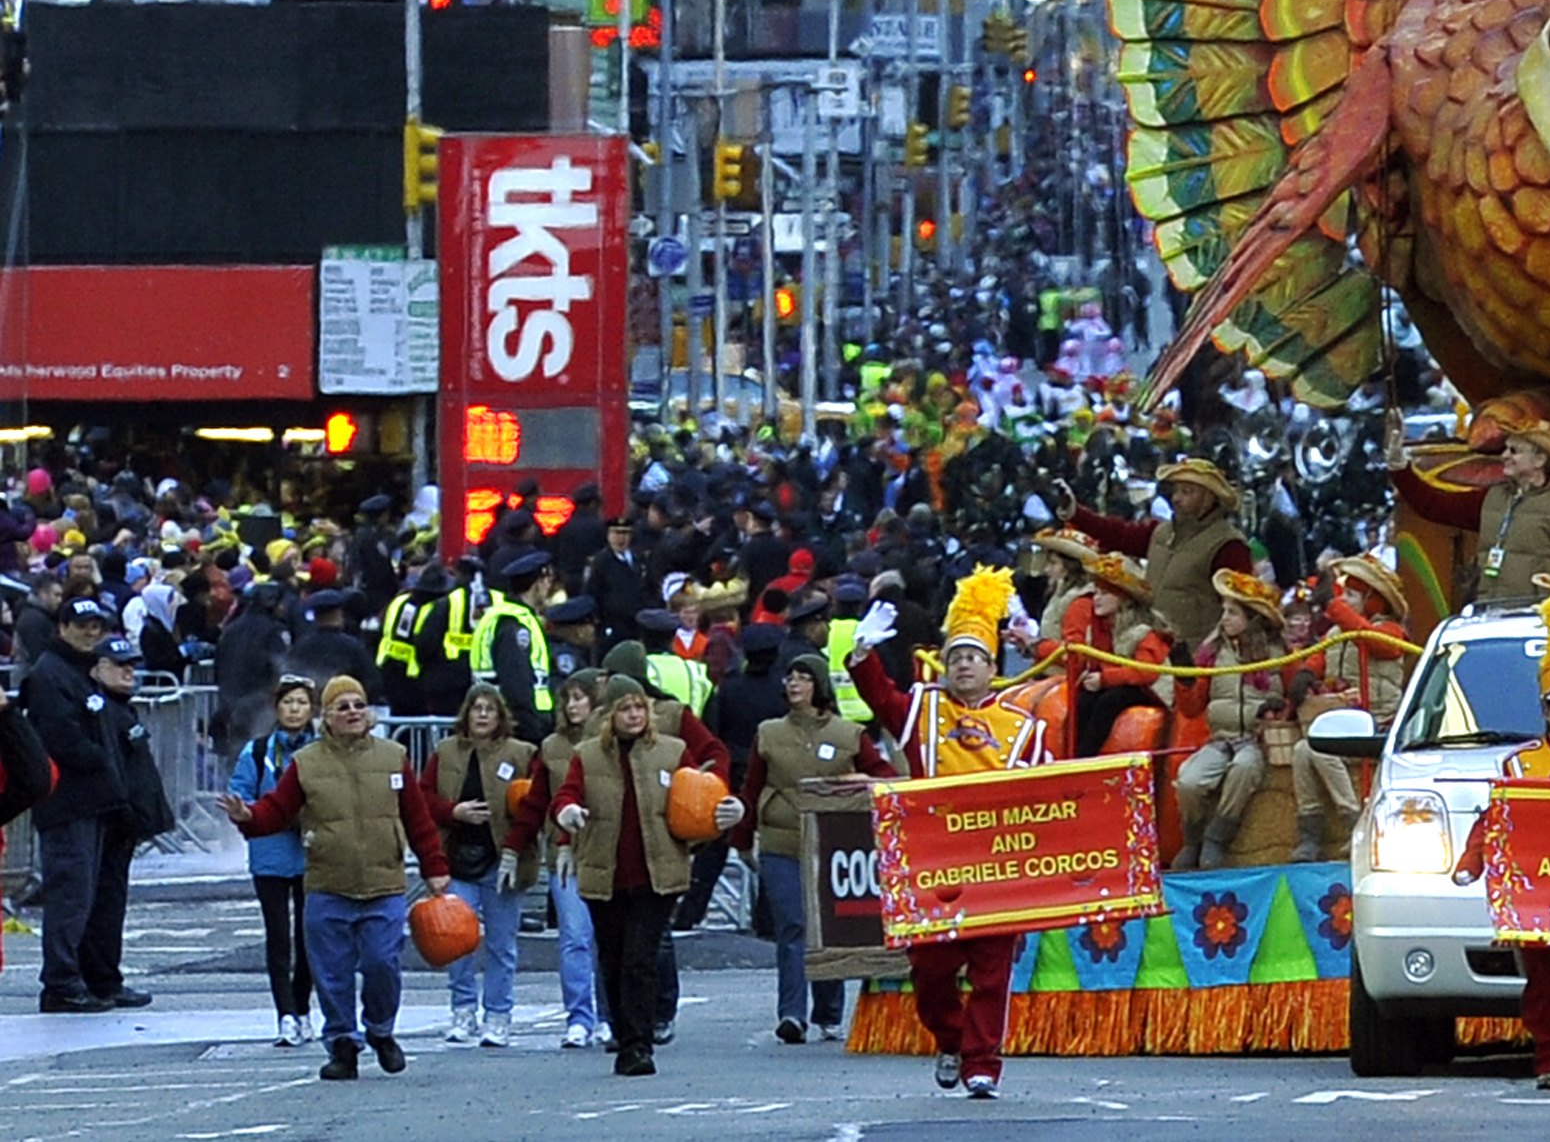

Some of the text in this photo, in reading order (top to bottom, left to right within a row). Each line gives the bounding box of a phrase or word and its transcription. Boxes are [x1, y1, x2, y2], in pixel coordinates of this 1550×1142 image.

[487, 155, 598, 382] tkts
[946, 800, 1078, 833] DEBI MAZAR
[991, 831, 1037, 855] AND
[916, 848, 1120, 890] GABRIELE CORCOS
